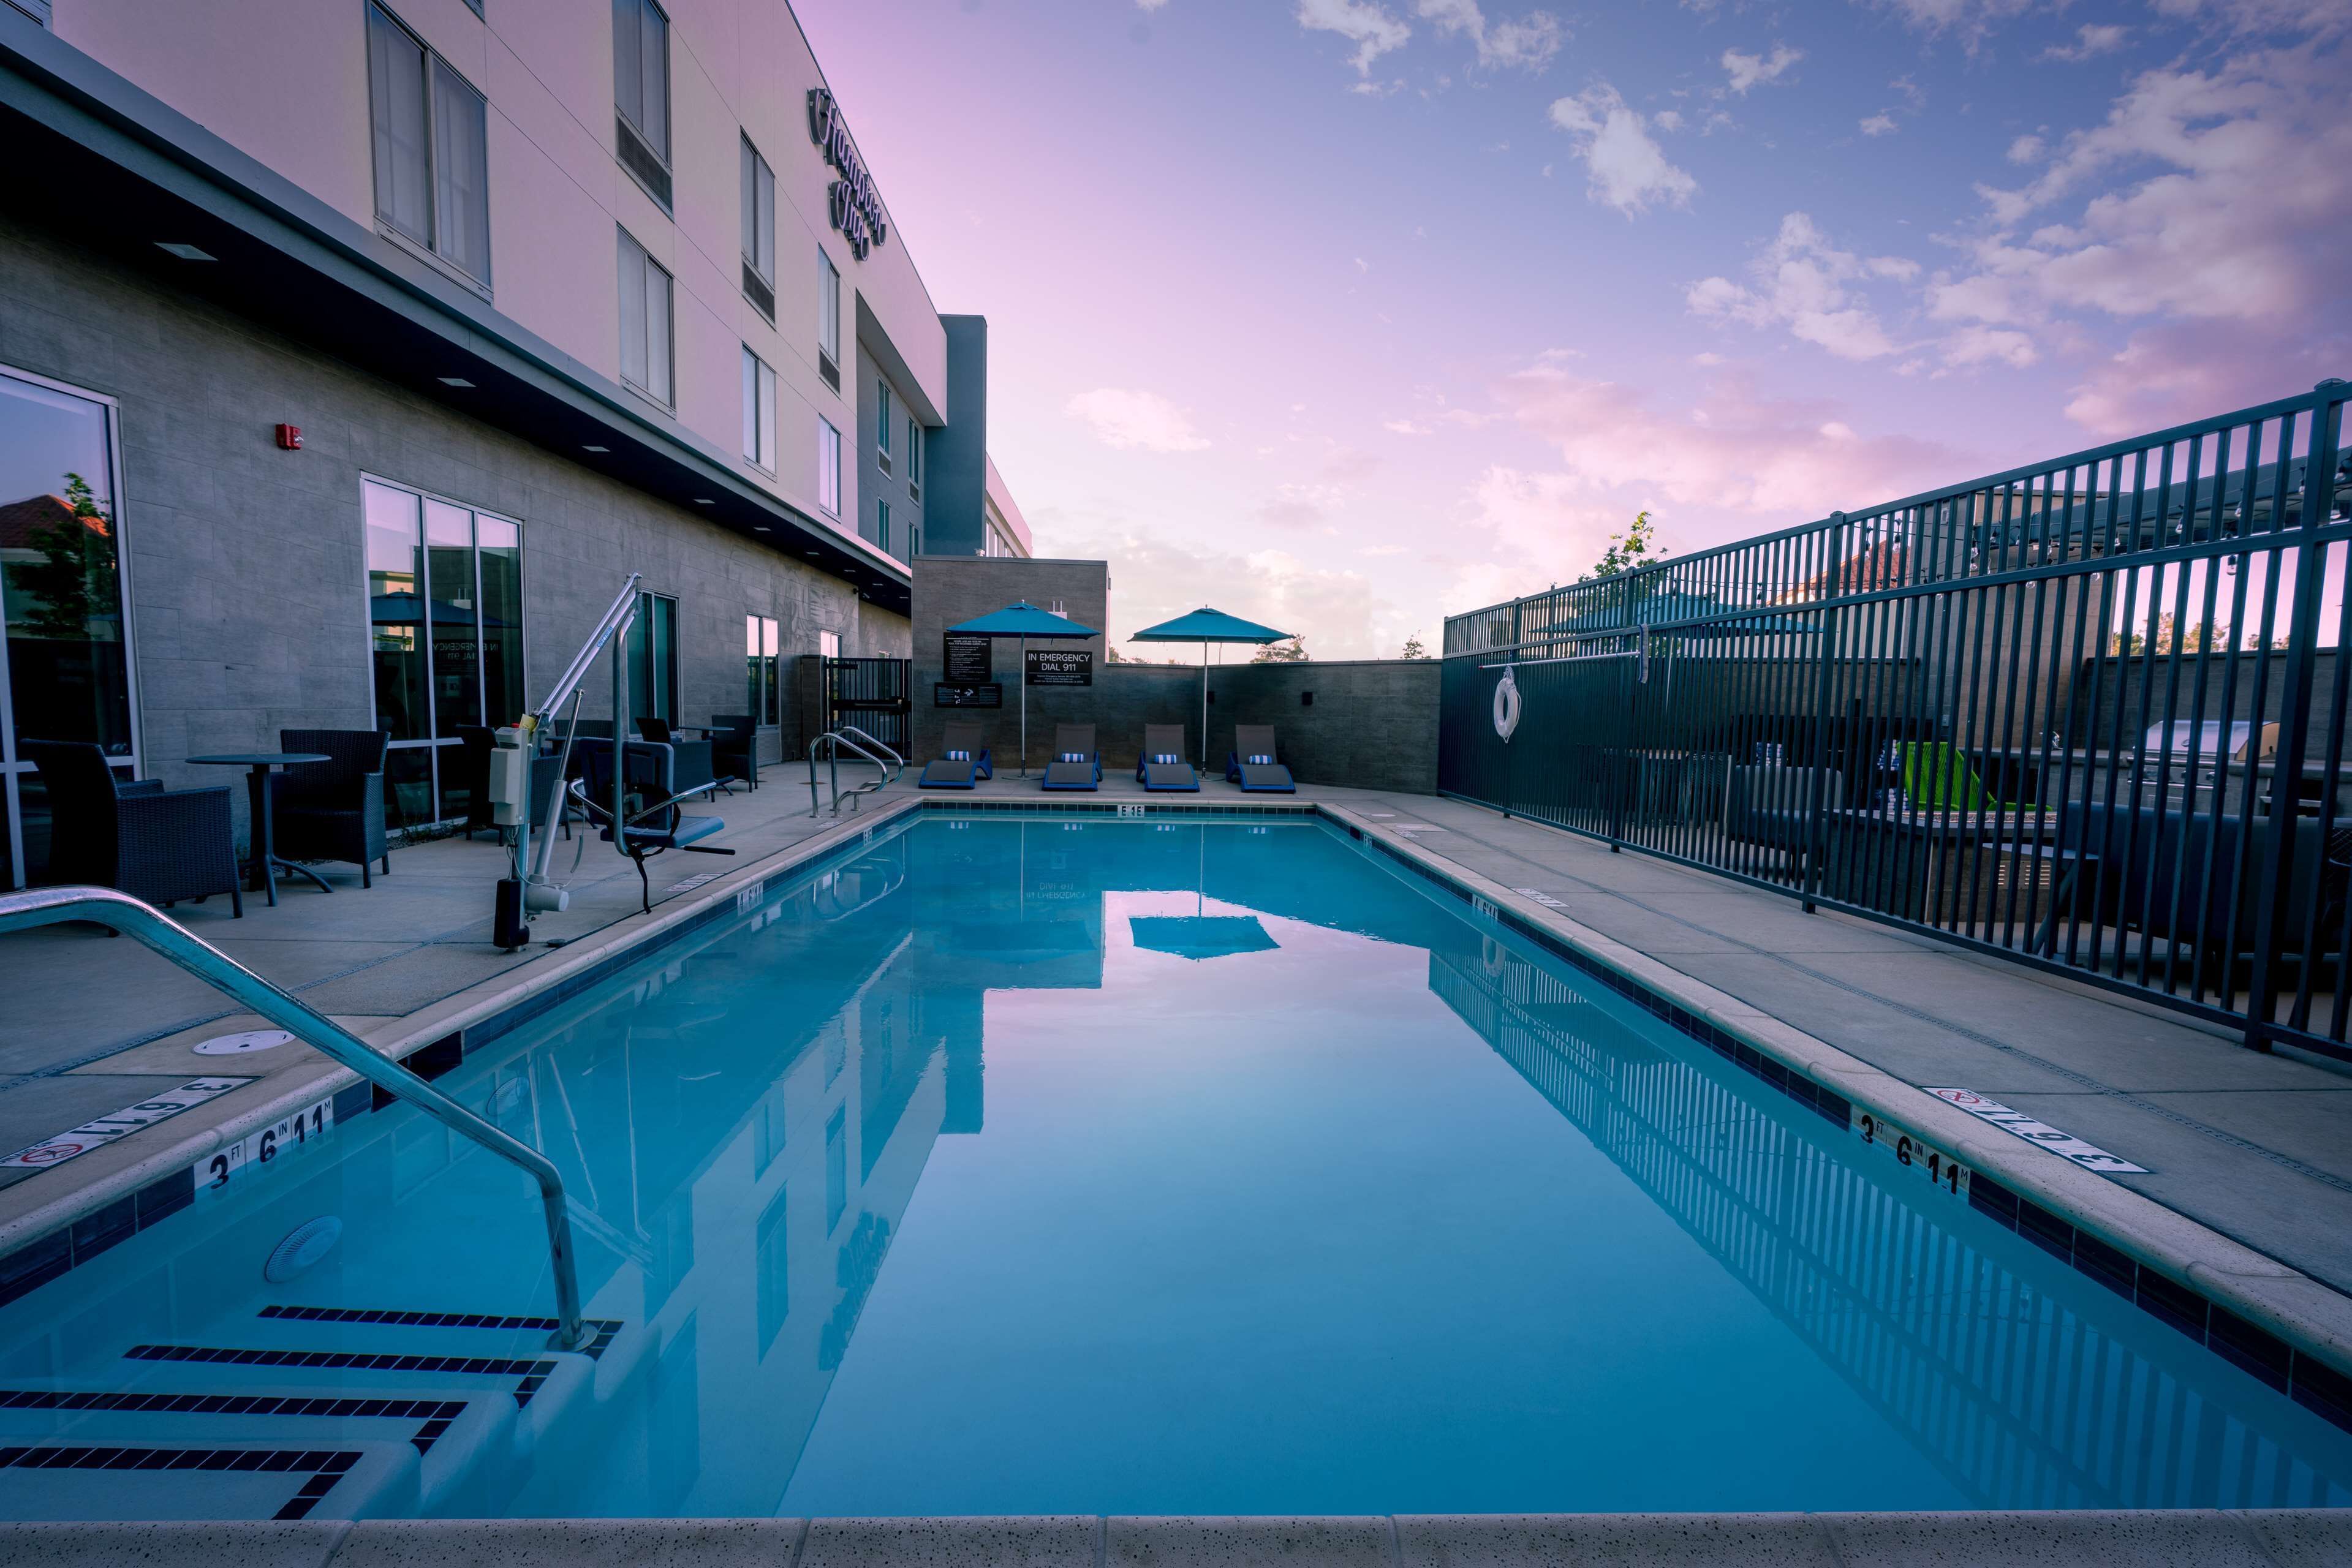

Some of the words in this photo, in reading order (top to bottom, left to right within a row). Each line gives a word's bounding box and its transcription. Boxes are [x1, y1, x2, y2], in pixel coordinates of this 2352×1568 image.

[807, 87, 886, 246] Hampton
[828, 181, 869, 262] Inn
[1040, 654, 1090, 662] EMERGENCY
[210, 1154, 229, 1189] 3
[231, 1144, 240, 1161] FT
[260, 1130, 277, 1163] 6
[279, 1121, 287, 1137] IN
[324, 1100, 331, 1112] M
[1860, 1115, 1874, 1144] 3
[1877, 1121, 1885, 1134] FT
[1897, 1136, 1912, 1166] 6
[1915, 1142, 1923, 1157] IN
[1961, 1168, 1968, 1181] M
[2022, 1133, 2073, 1141] 6
[2070, 1154, 2125, 1164] 3
